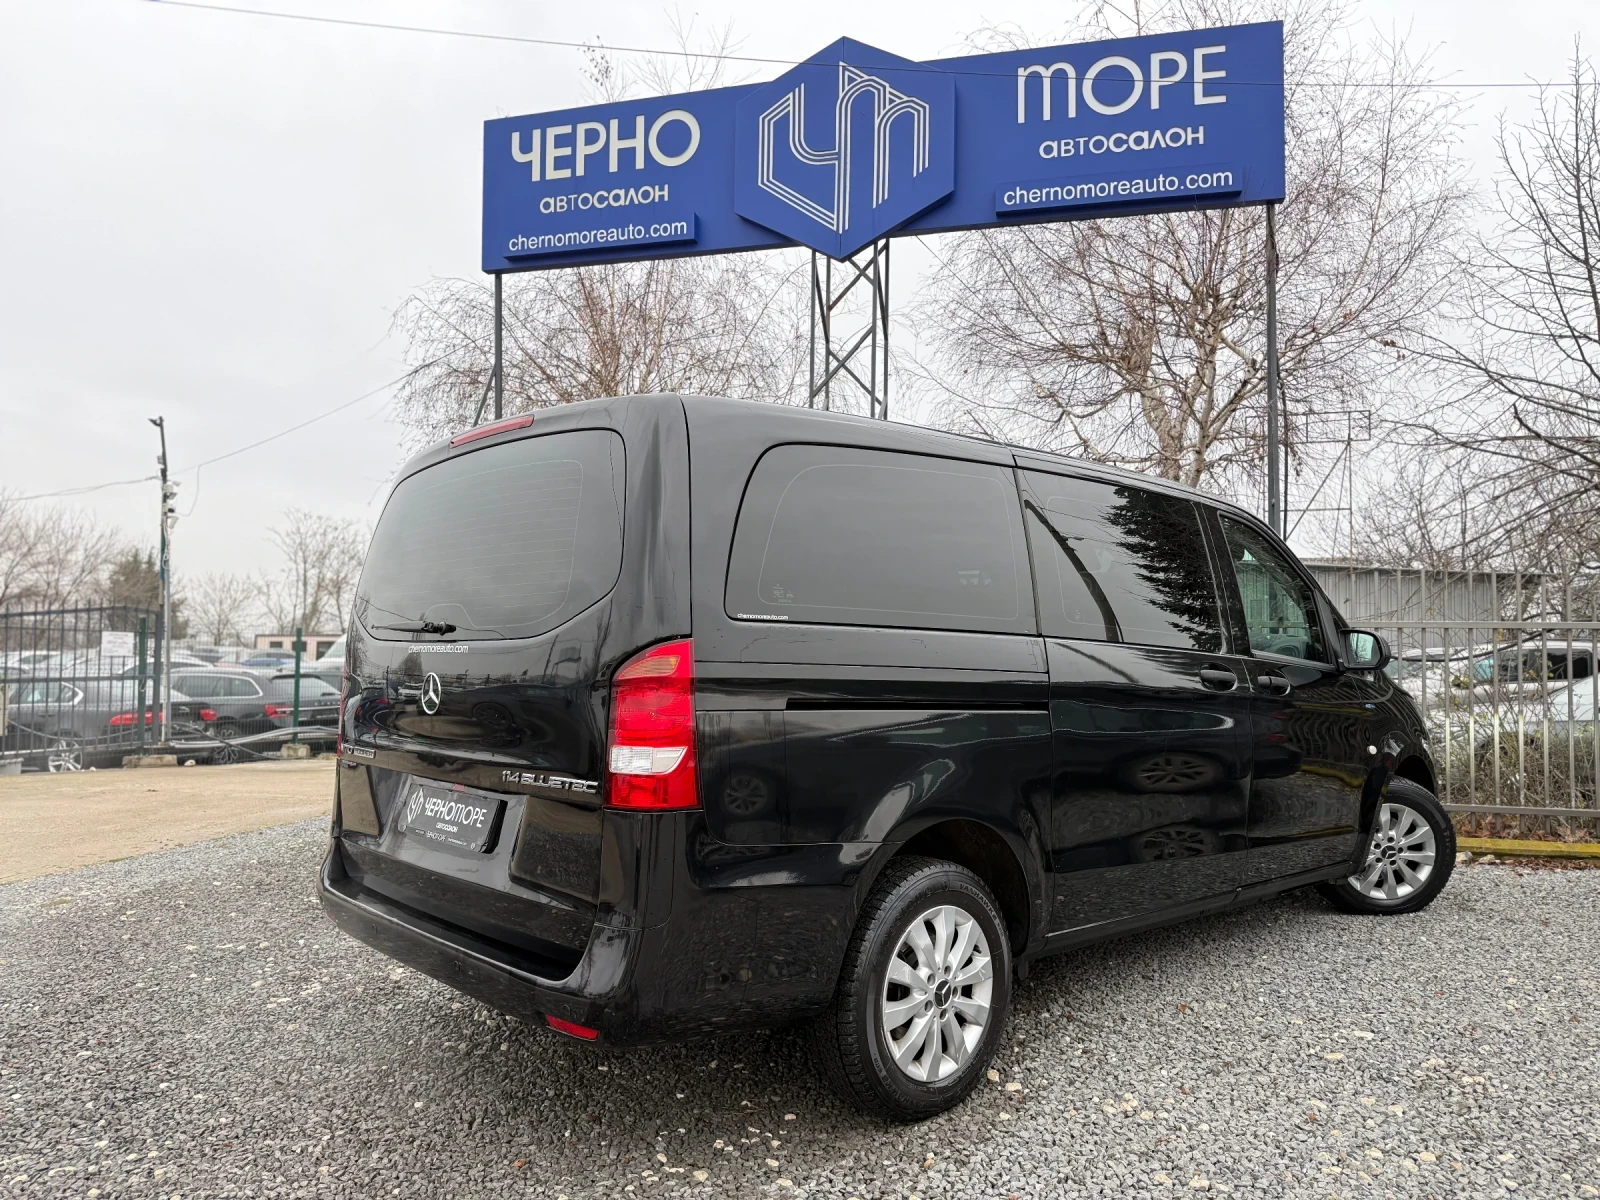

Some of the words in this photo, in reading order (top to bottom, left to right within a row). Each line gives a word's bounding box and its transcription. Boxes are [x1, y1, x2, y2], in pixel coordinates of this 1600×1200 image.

[510, 109, 701, 182] ЧЕРНО
[1003, 170, 1233, 206] chernomoreauto.com
[508, 220, 688, 252] chernomoreauto.com
[502, 770, 520, 784] 114
[521, 773, 599, 794] BLUETEC
